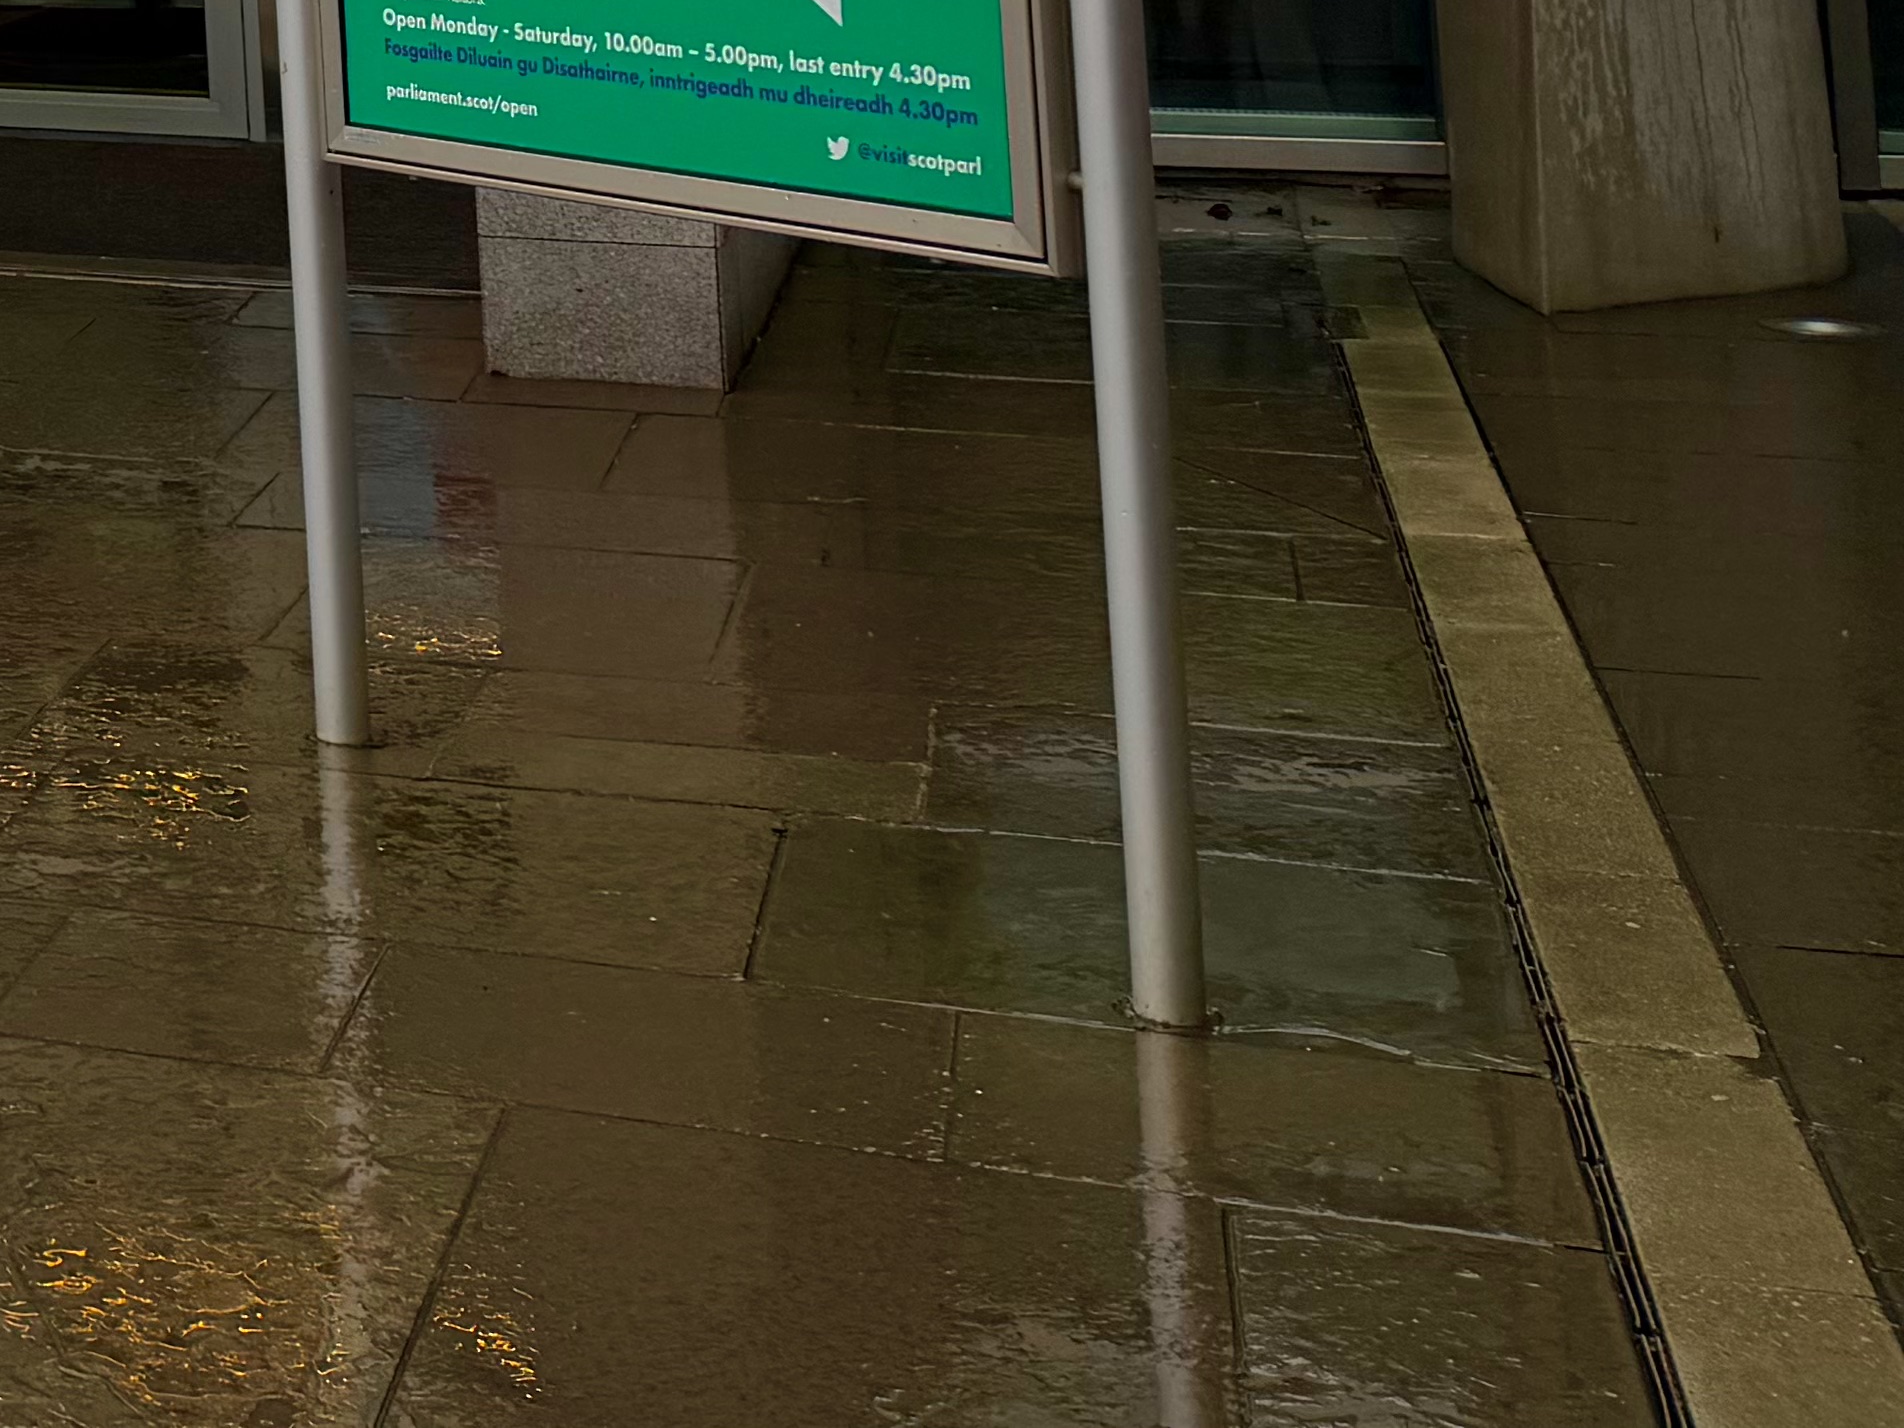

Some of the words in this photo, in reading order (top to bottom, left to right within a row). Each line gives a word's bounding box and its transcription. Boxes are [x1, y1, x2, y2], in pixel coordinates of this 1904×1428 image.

[382, 8, 426, 31] Open
[430, 13, 498, 42] Monday
[513, 22, 597, 53] Saturday,
[604, 31, 683, 58] 10.00am
[704, 42, 784, 73] 5.00pm,
[789, 50, 825, 74] last
[829, 60, 884, 86] entry
[889, 62, 971, 93] 4.30pm
[384, 38, 453, 63] Fosgailte
[457, 46, 512, 70] Diluain
[517, 58, 538, 76] gu
[543, 55, 644, 88] Disathairne,
[650, 68, 754, 99] inntrigeadh
[759, 87, 788, 104] mu
[793, 85, 893, 116] dheireadh
[898, 97, 978, 129] 4.30pm
[386, 82, 538, 118] parliament.scot/open
[858, 142, 982, 177] @visitscotparl
